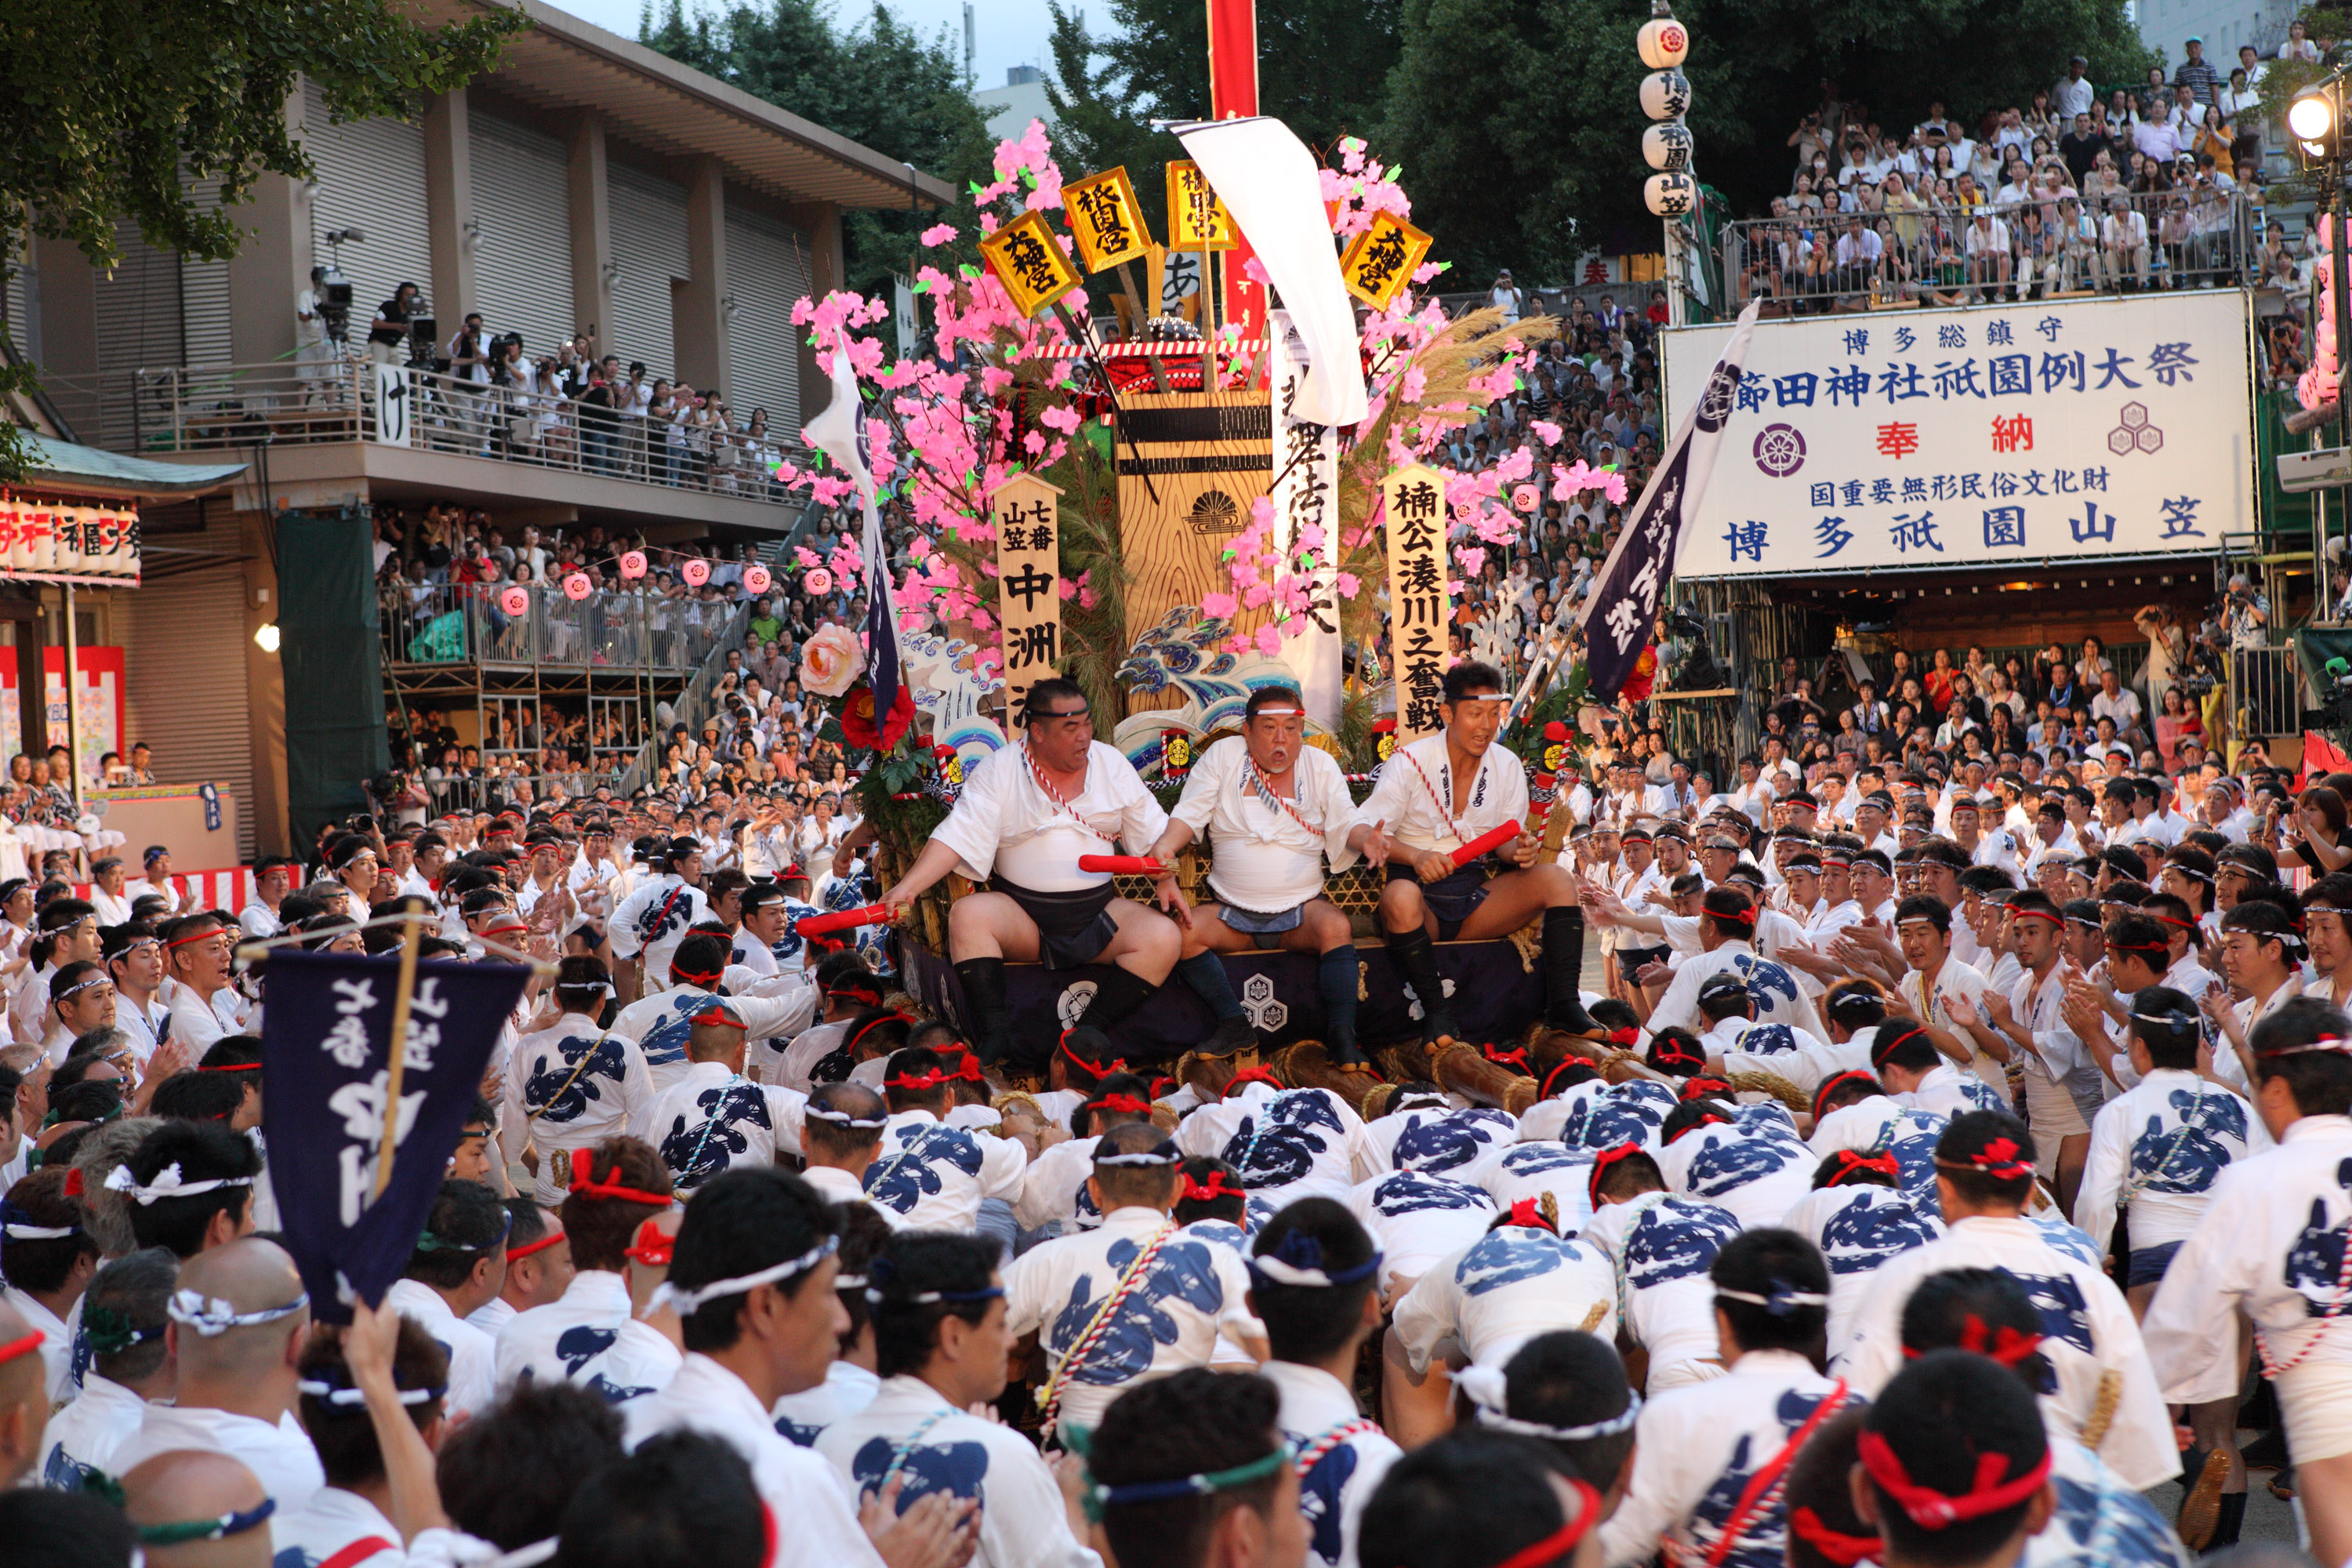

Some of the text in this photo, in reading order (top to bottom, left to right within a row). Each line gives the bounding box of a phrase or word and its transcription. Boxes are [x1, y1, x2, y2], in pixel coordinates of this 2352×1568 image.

[1659, 72, 1691, 214] 博多祇園山笠
[1842, 316, 2063, 355] 博多総鎮守
[381, 370, 407, 441] け
[1876, 413, 2034, 459] 奉納
[1810, 466, 2110, 507] 国重要無形民俗文化財
[1002, 502, 1028, 552] 山笠
[1027, 500, 1054, 551] 七番
[1722, 495, 2205, 562] 博多祇園山笠
